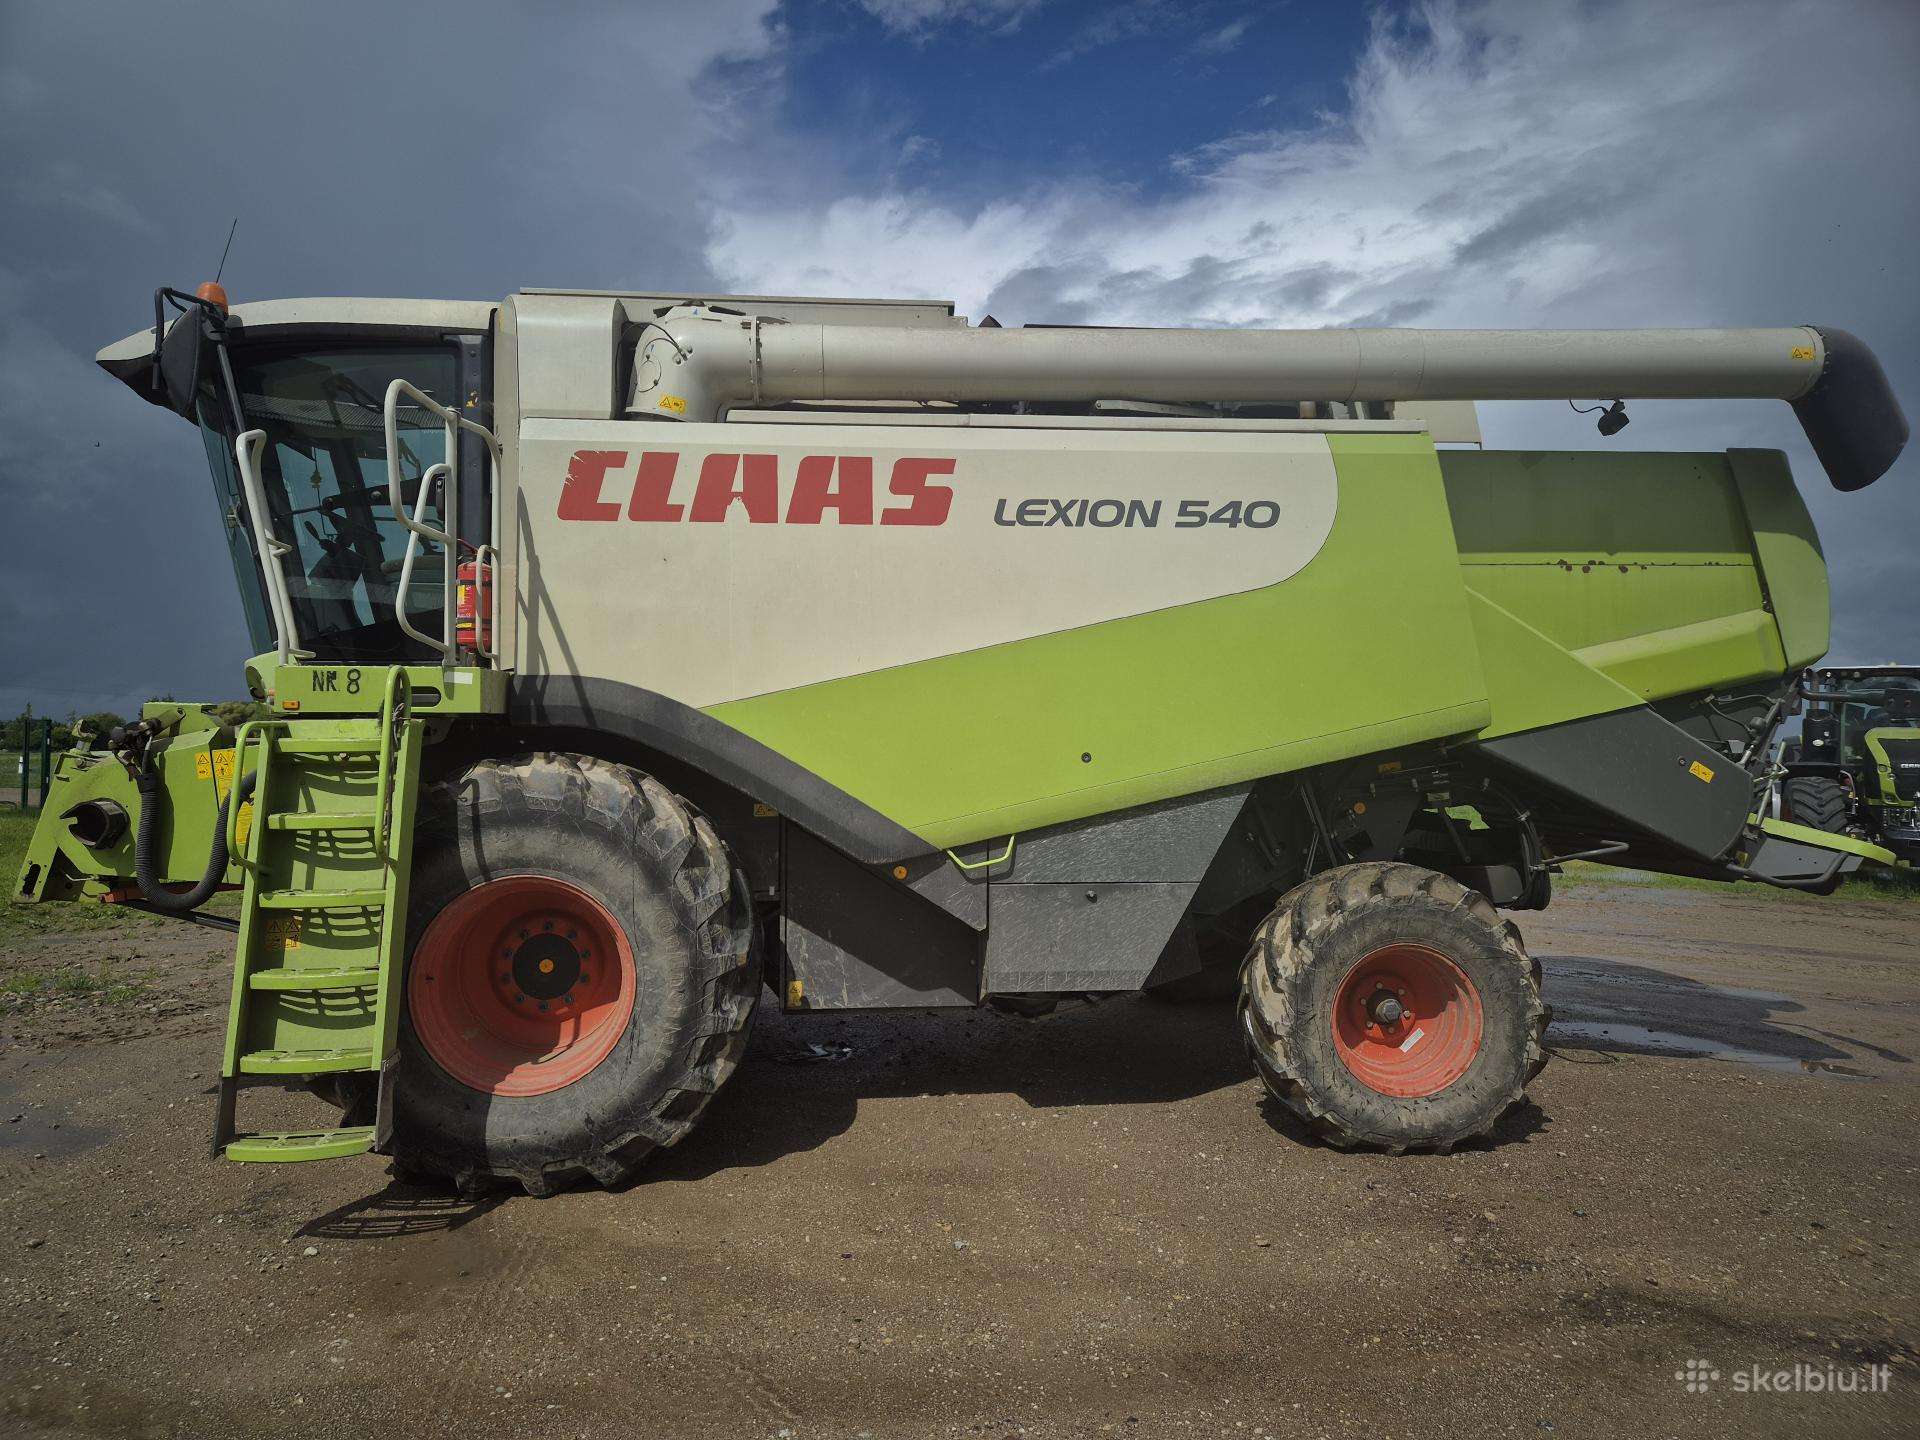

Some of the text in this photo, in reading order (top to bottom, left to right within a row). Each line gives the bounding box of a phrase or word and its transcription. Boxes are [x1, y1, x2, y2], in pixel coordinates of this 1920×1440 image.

[557, 449, 957, 526] CLAAS
[994, 498, 1281, 528] LEXION 540
[347, 668, 361, 694] 8
